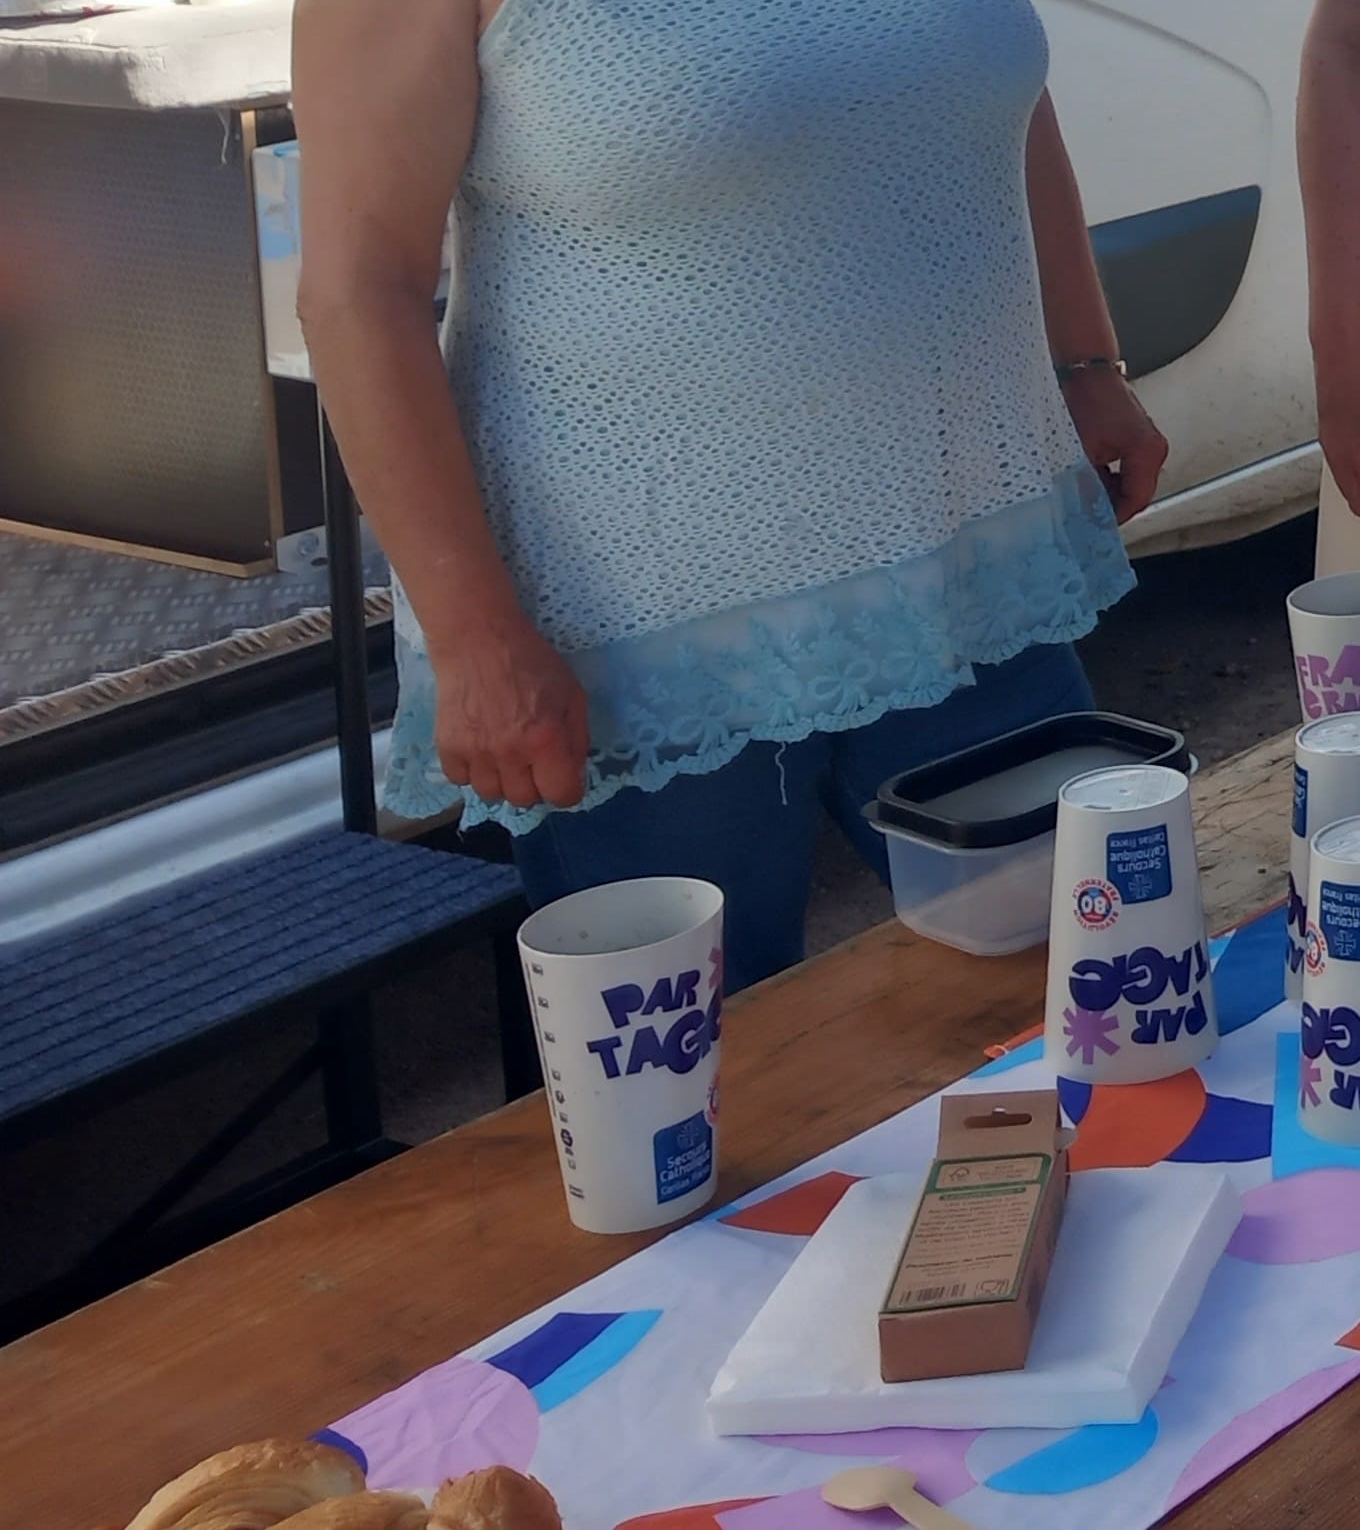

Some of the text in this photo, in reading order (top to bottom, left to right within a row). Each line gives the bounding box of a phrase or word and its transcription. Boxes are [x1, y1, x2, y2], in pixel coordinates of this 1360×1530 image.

[1110, 844, 1167, 862] Catholique
[1117, 857, 1162, 873] Secours
[1080, 895, 1107, 914] 80
[600, 969, 701, 1029] PAR
[1130, 990, 1208, 1044] PAR
